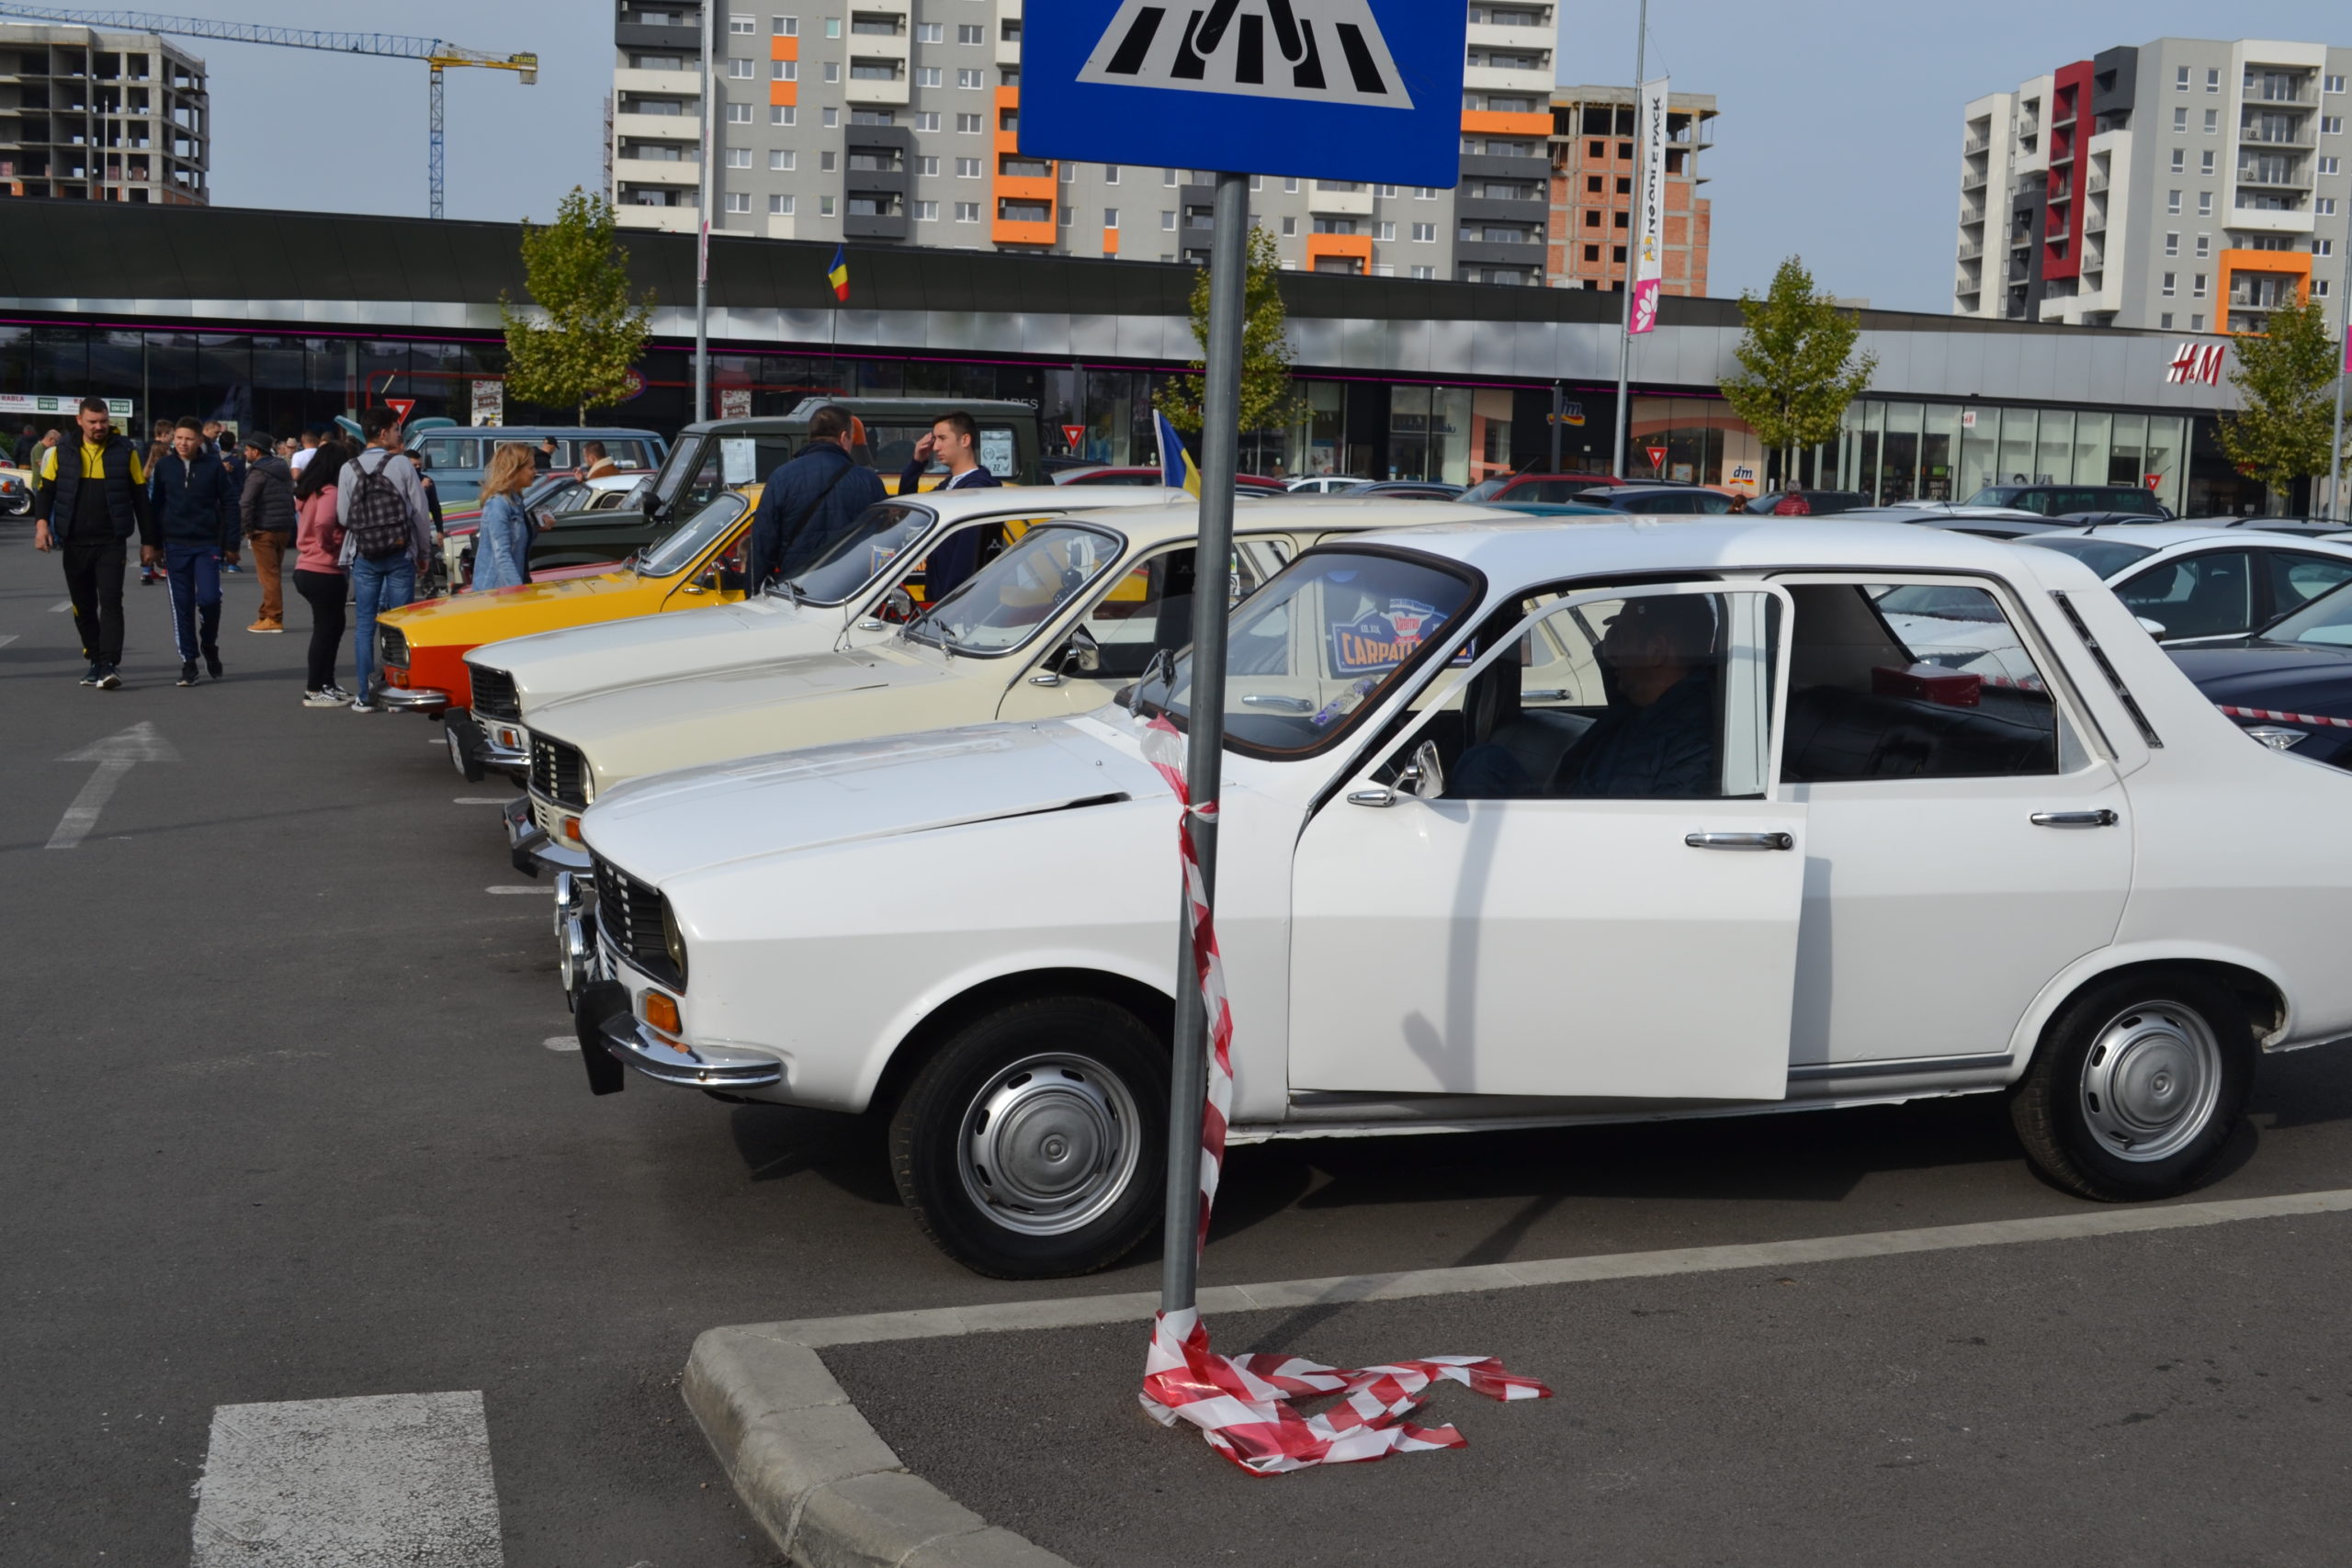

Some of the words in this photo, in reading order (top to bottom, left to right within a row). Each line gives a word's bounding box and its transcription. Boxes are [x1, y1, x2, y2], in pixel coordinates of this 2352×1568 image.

[1652, 97, 1660, 146] PACK
[1648, 152, 1658, 233] NOODLE
[2166, 343, 2225, 387] H&M
[1733, 466, 1753, 479] dm
